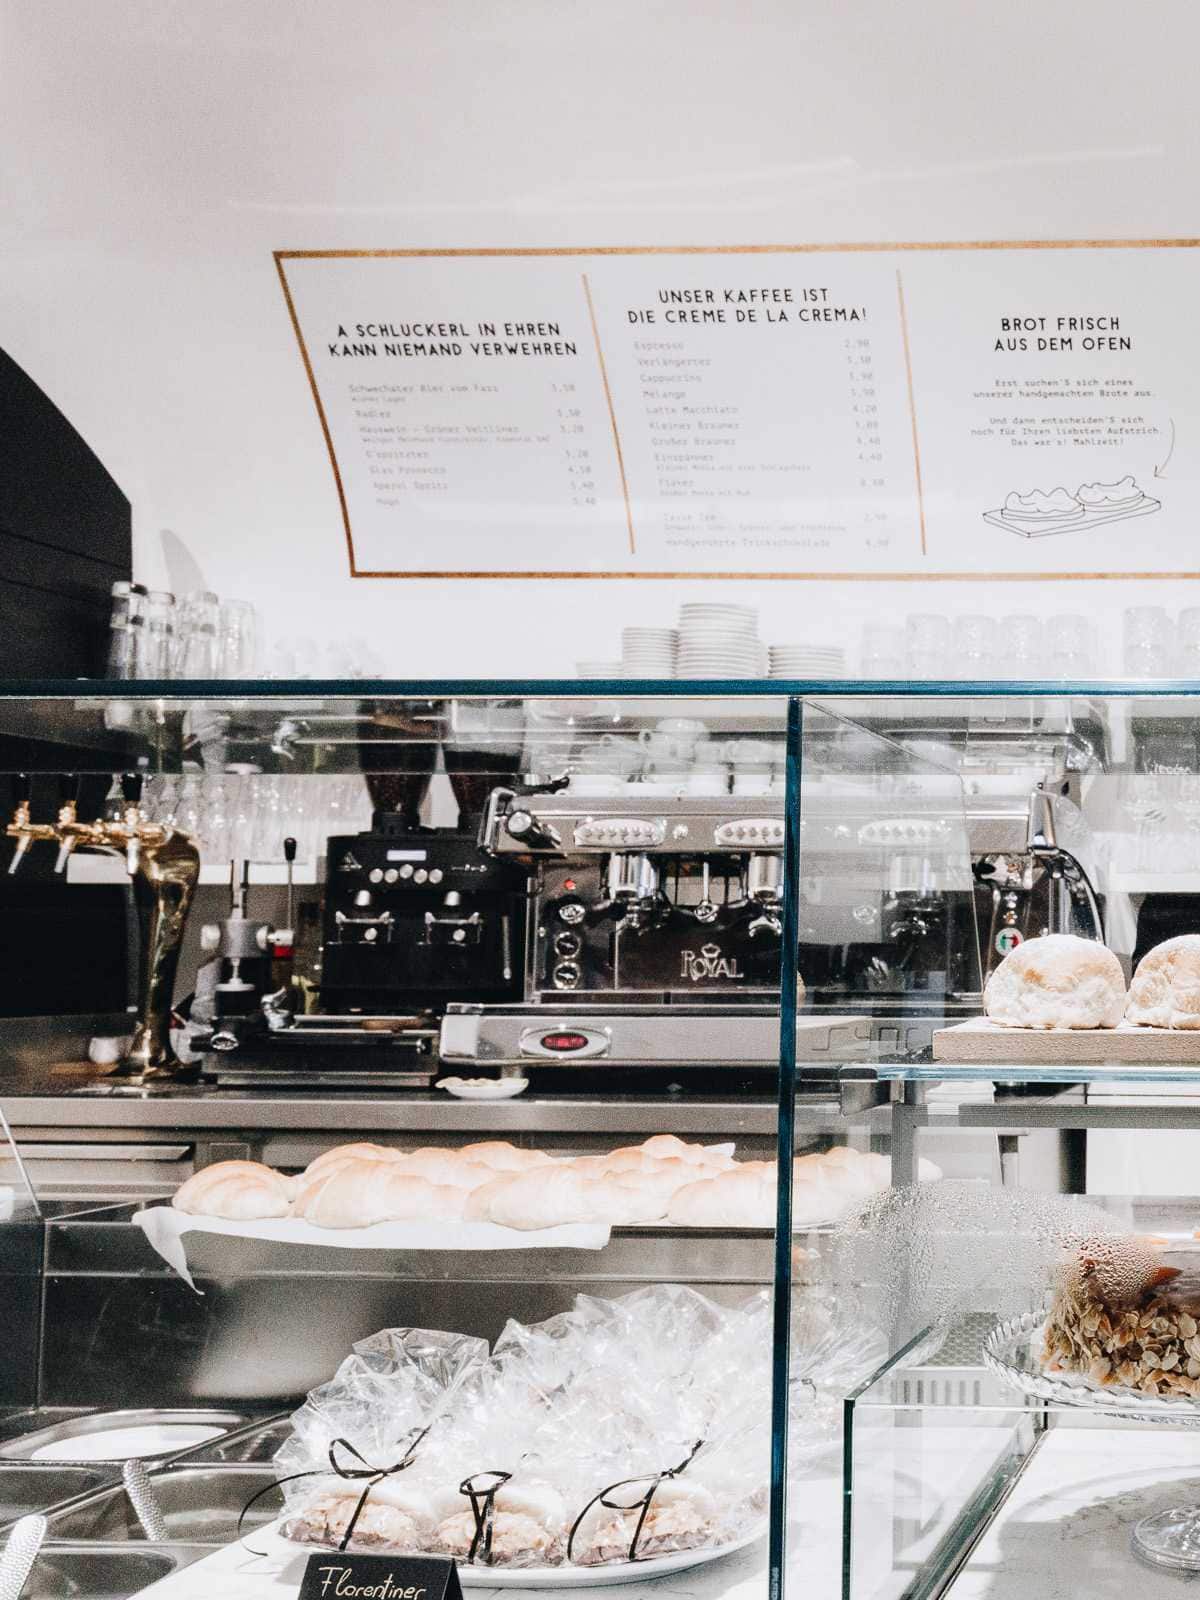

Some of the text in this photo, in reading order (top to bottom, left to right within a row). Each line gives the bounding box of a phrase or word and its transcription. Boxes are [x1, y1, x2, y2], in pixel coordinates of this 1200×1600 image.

[658, 287, 829, 304] UNSER KAFFEE IST
[627, 307, 867, 324] DIE CREME DE LA CREMA!
[337, 323, 561, 337] A SCHLUCKERL IN EHREN
[1000, 316, 1120, 331] BROT FRISCH
[328, 342, 578, 357] KANN NIEMAND VERWEHREN
[994, 336, 1132, 352] AUS DEM OFEN
[1076, 378, 1099, 387] sich
[1011, 416, 1036, 425] dann
[1121, 415, 1144, 425] sich
[680, 949, 744, 981] ROYAL
[319, 1566, 427, 1600] Florentiner
